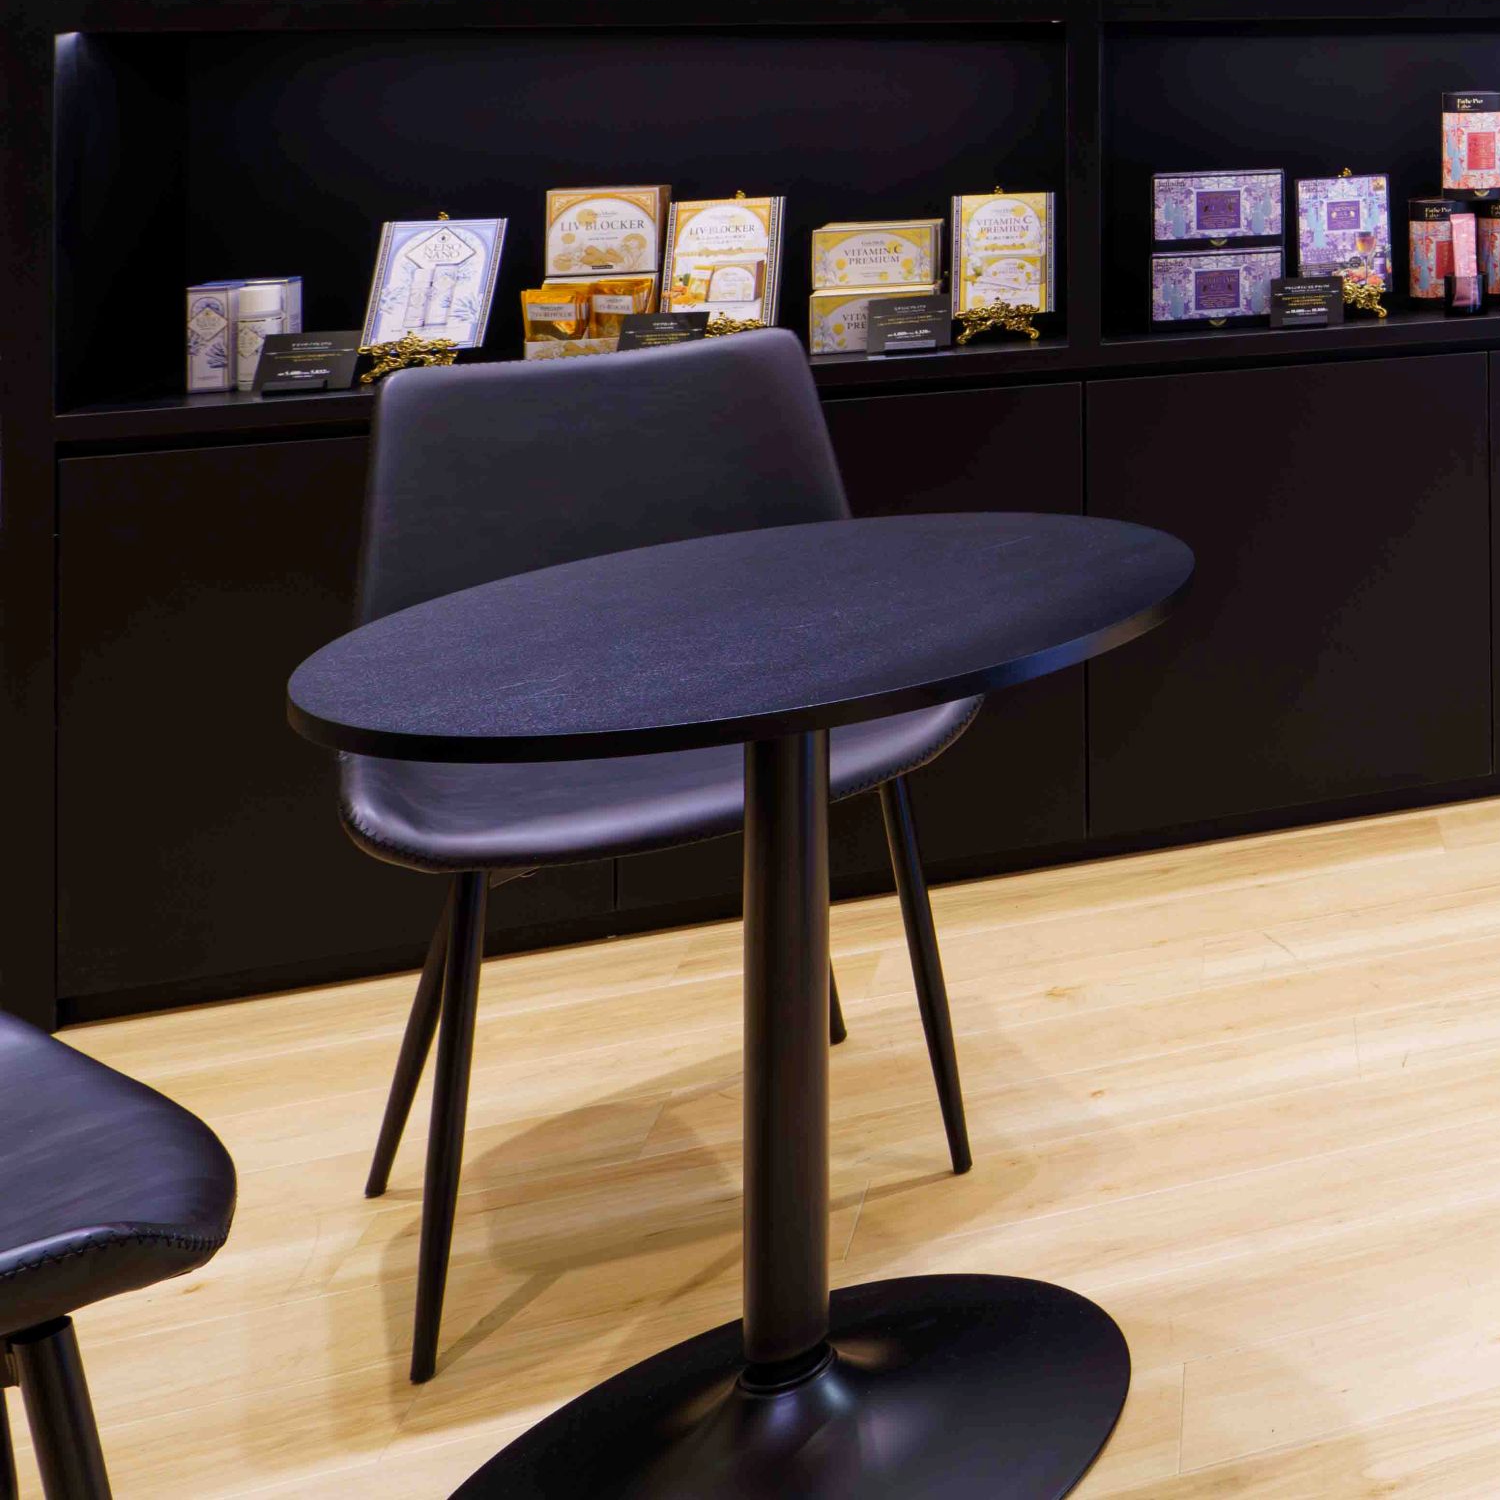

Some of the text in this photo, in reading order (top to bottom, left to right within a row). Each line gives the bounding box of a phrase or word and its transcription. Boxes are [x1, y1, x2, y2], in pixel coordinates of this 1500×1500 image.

[560, 219, 645, 232] LIV BLOCKER
[976, 214, 1033, 227] VITAMIN C
[980, 224, 1029, 234] PREMIUM
[844, 244, 902, 257] VITAMIN C
[848, 255, 900, 265] PREMIUM
[842, 312, 867, 321] VITA
